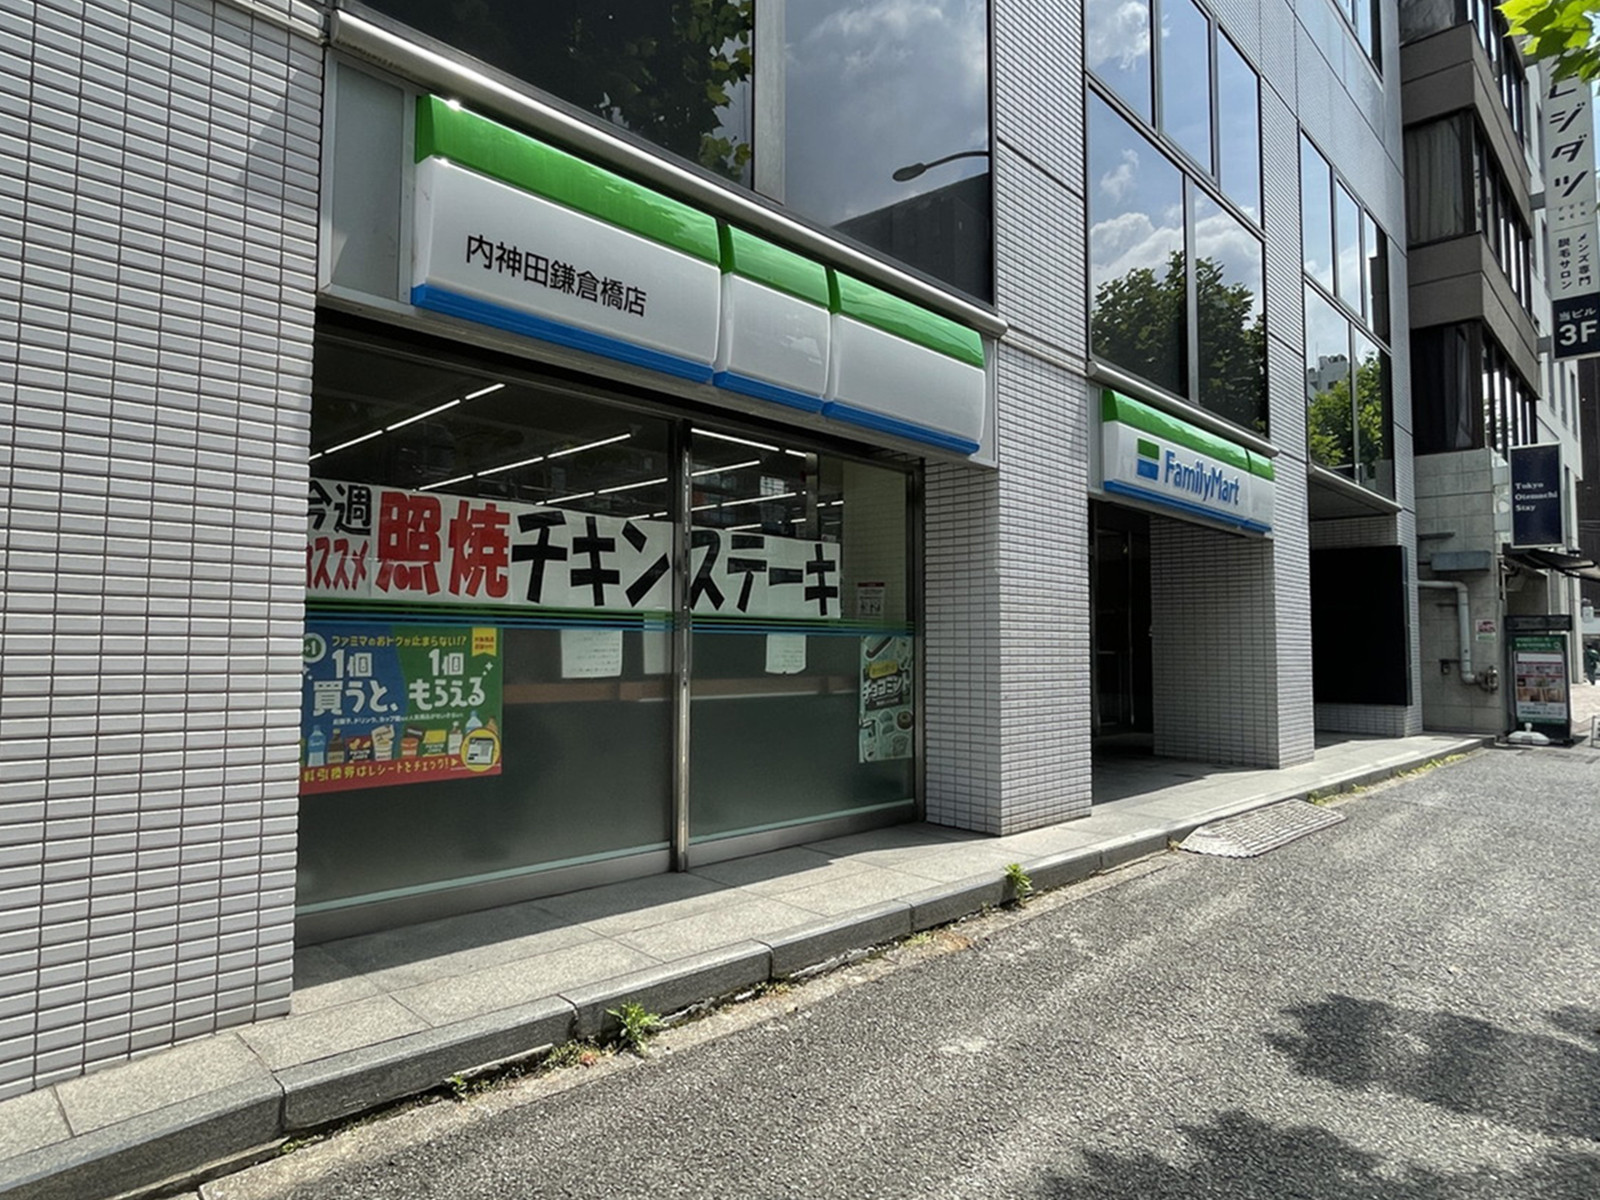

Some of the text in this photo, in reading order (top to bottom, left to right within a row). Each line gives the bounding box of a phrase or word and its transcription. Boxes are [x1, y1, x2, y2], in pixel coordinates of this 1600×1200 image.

[465, 234, 647, 317] 内神田鎌倉橋店
[1558, 237, 1573, 290] 脱毛サロン
[1577, 232, 1592, 287] メンズ専門
[1558, 307, 1597, 322] 当ビル
[1559, 319, 1598, 346] 3F
[1164, 450, 1240, 505] FamilyMart
[1515, 482, 1544, 491] Tokyo
[1514, 491, 1558, 501] Otemachi
[1515, 504, 1536, 512] Stay
[306, 536, 369, 591] ススメ
[332, 649, 373, 679] 1個
[429, 648, 465, 676] 1個
[313, 680, 399, 717] 買うと、
[409, 677, 486, 711] もらえる
